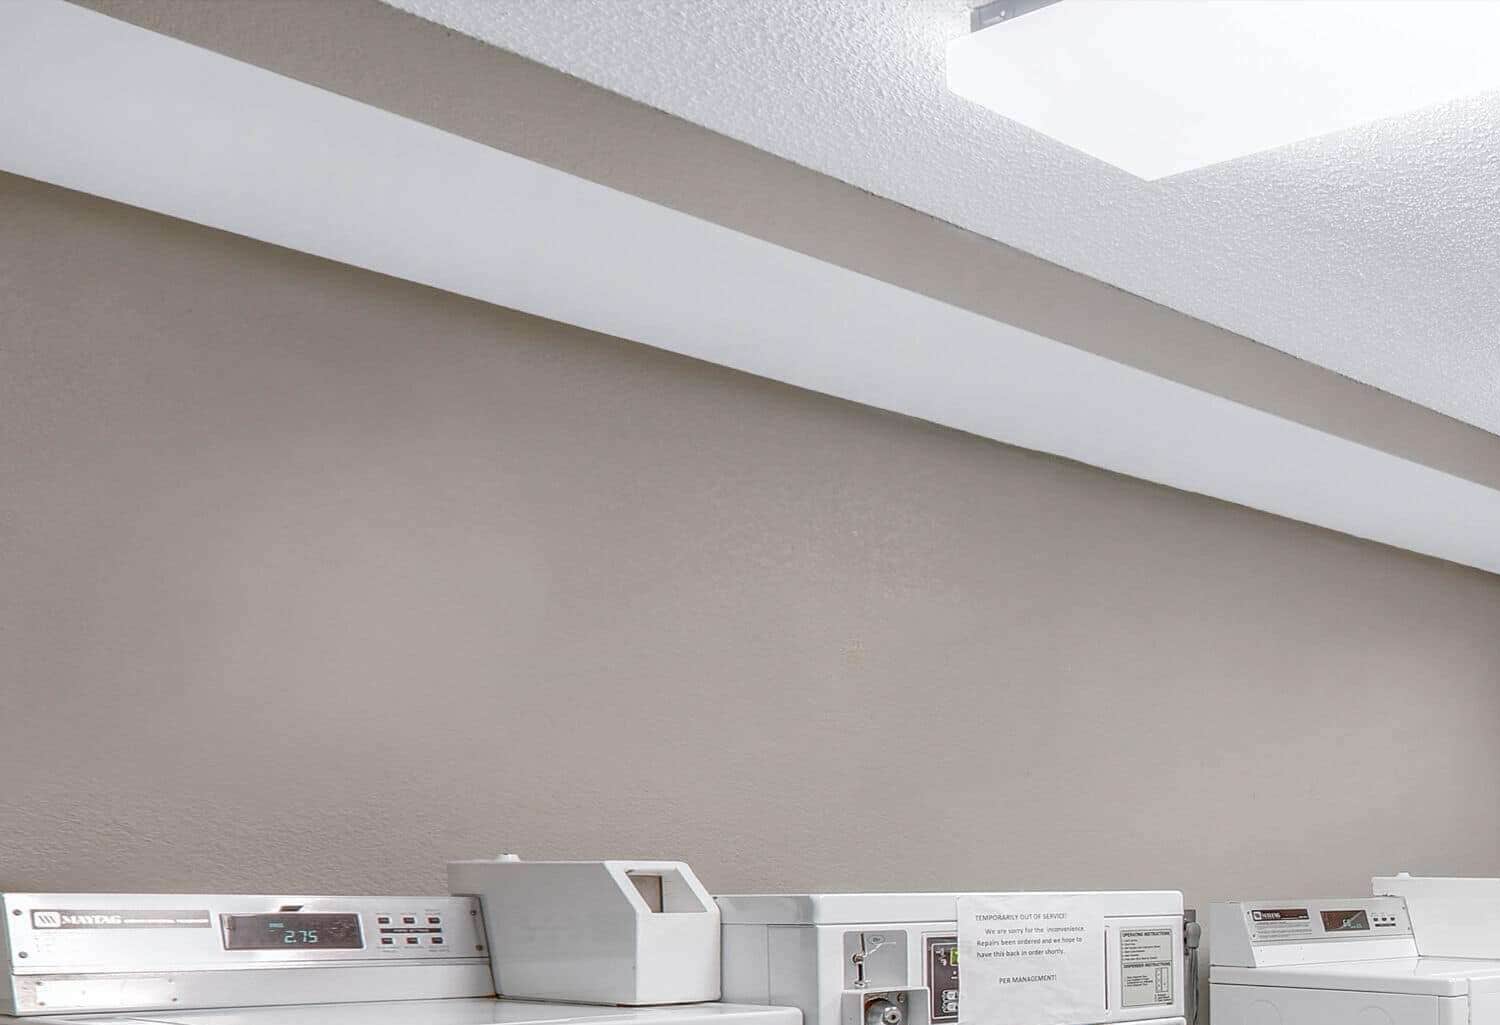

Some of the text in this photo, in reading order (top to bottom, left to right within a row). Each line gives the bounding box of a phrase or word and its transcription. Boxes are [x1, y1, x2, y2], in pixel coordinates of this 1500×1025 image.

[284, 930, 318, 943] 2.75
[977, 940, 1000, 948] Repairs
[1061, 936, 1075, 944] hope
